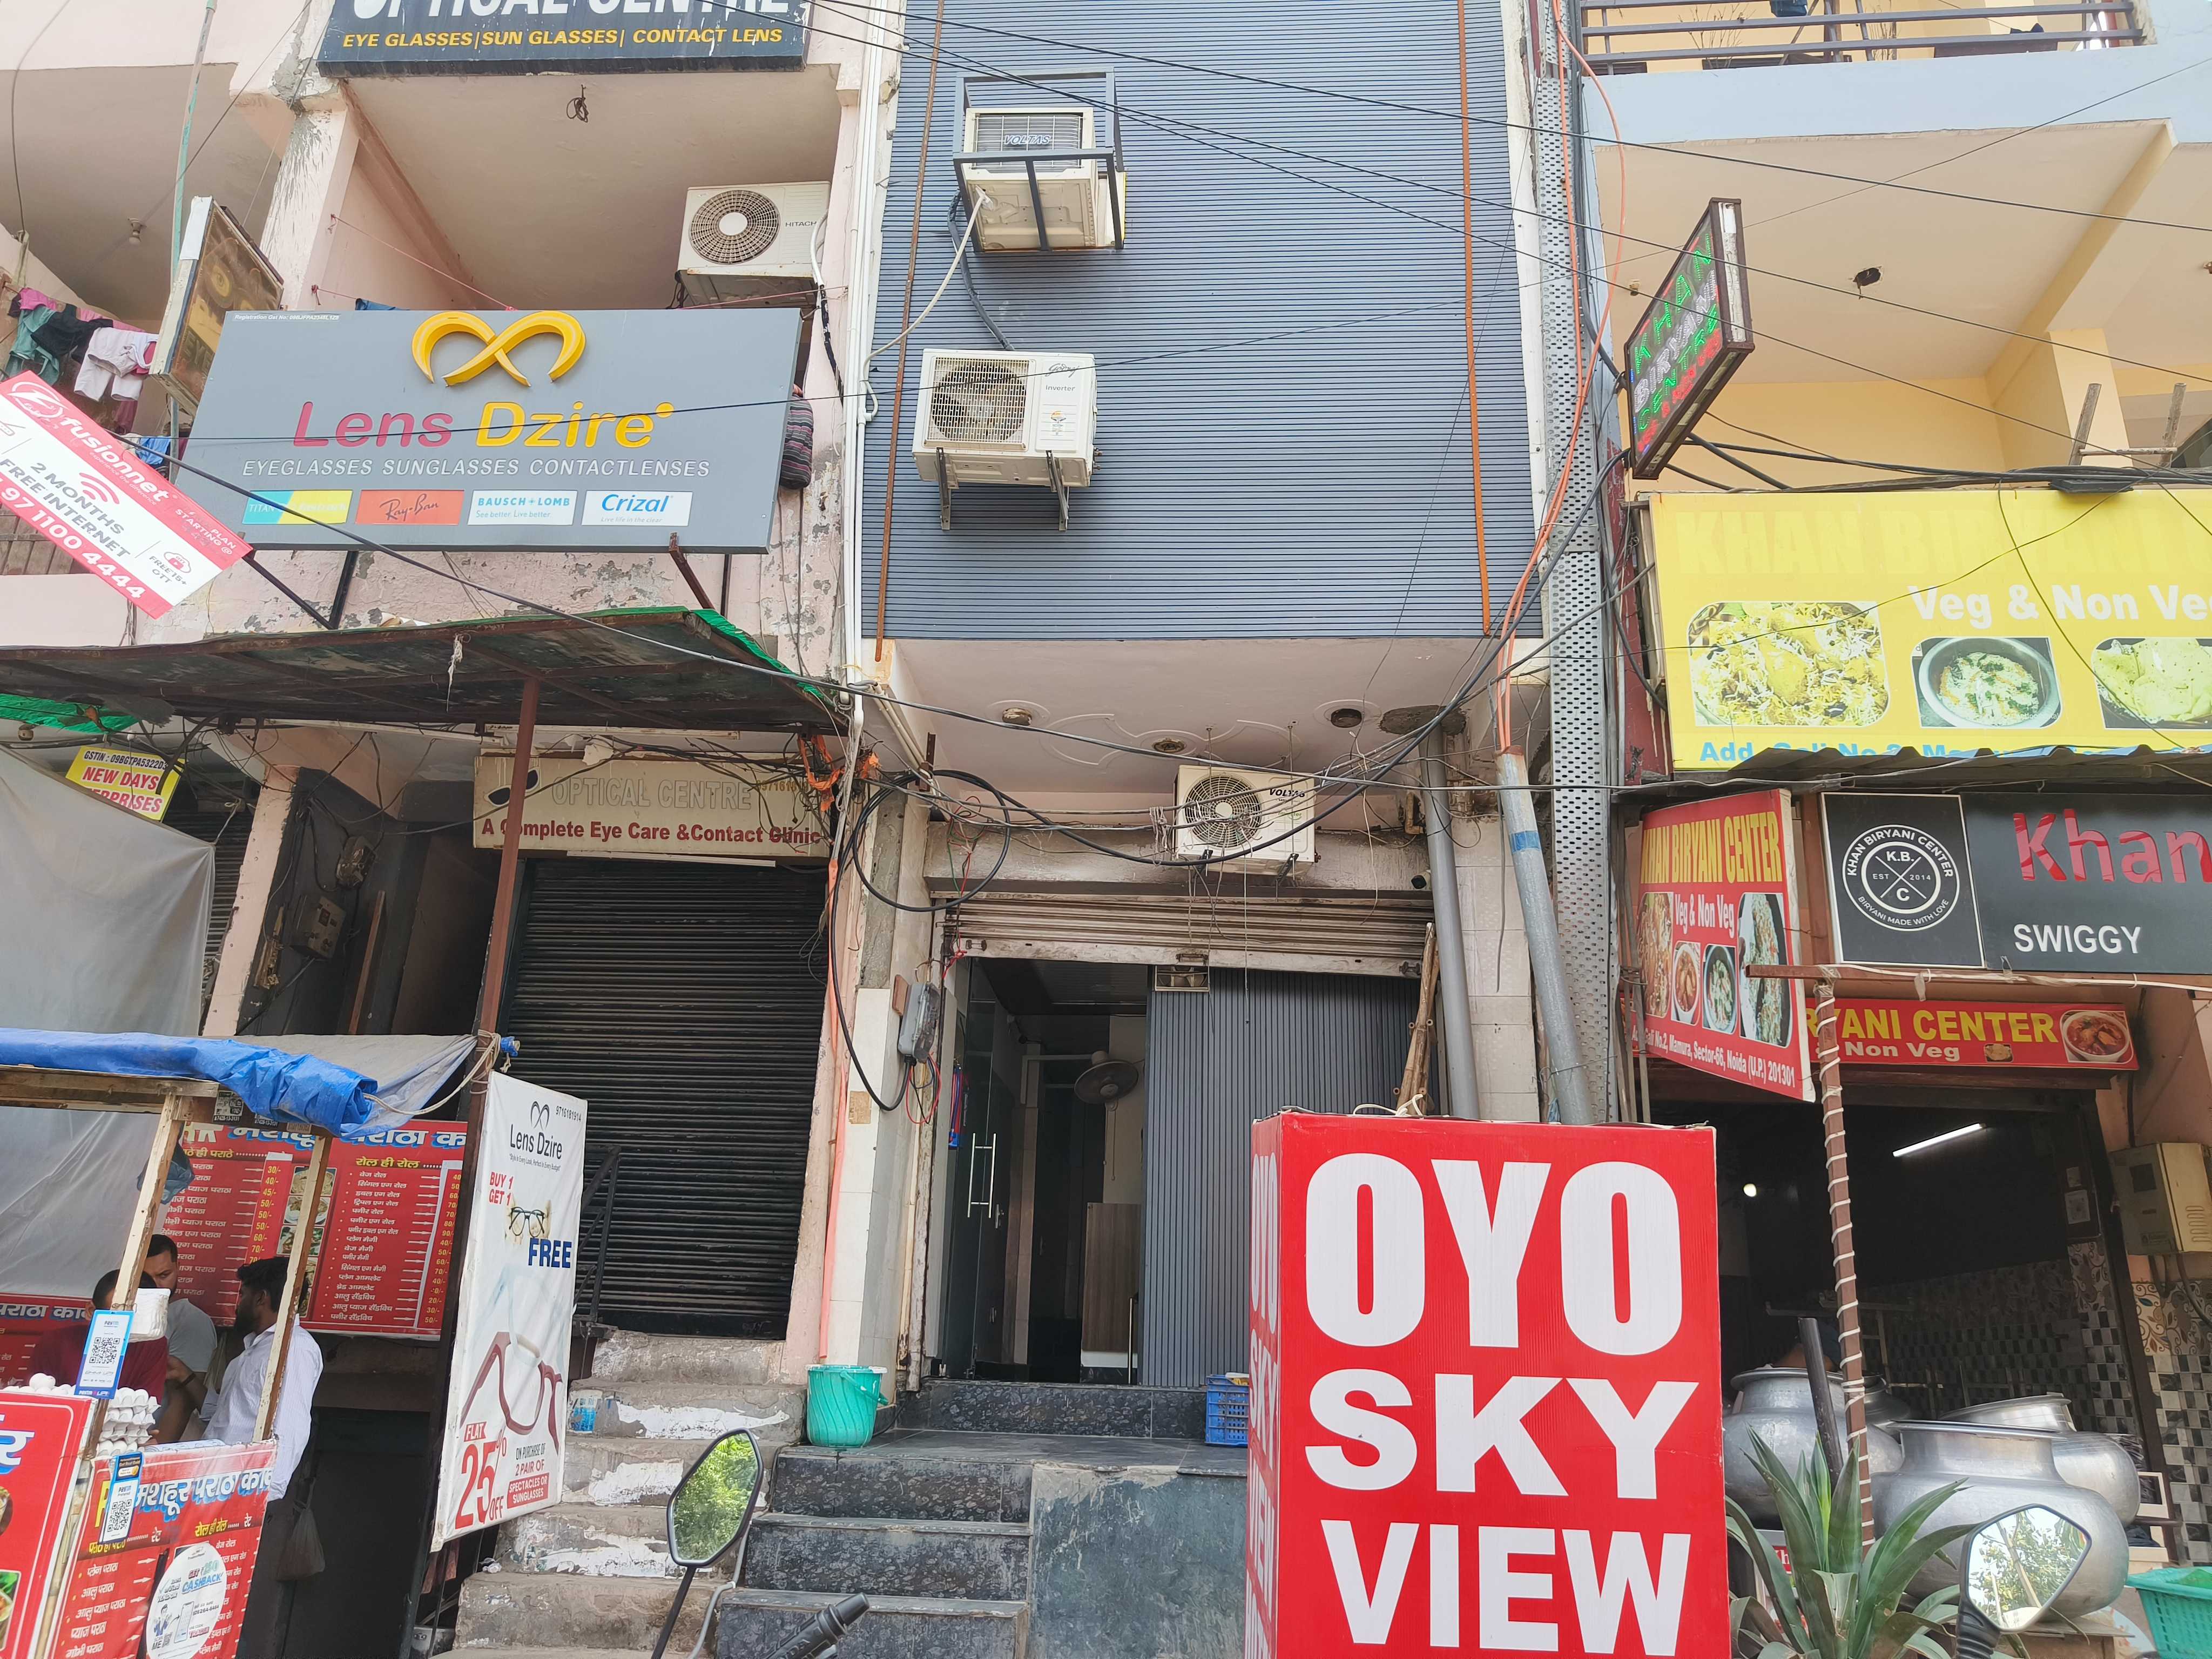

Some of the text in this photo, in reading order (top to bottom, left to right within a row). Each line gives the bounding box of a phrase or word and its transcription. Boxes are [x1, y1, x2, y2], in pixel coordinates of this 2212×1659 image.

[343, 34, 380, 48] EYE
[633, 29, 727, 43] CONTACT
[732, 29, 783, 43] LENS
[1004, 134, 1051, 145] VOLTAS
[293, 401, 657, 448] Lens Dzire
[60, 417, 169, 502] fusionnet
[242, 458, 710, 476] EYEGLASSES SUNGLASSES CONTACTLENSES
[31, 462, 125, 535] 2 MONTHS
[478, 497, 527, 506] BAUSCH
[538, 498, 571, 506] LOMB
[602, 494, 670, 512] Crizal
[43, 491, 132, 559] INTERNET
[175, 509, 222, 547] STARTING
[31, 509, 84, 550] 1100
[80, 552, 148, 599] 4444
[1676, 510, 1865, 574] KHAN
[1908, 584, 2212, 630] Veg & Non Ve
[82, 767, 160, 791] NEW DAYS
[552, 777, 650, 807] OPTICAL
[658, 778, 752, 810] CENTRE
[481, 819, 495, 835] A
[590, 821, 622, 842] Eye
[628, 822, 670, 840] Care
[2013, 808, 2212, 883] Khan
[1671, 819, 1723, 883] BIRYANI
[1724, 811, 1783, 884] CENTER
[1847, 829, 1954, 878] KHAN BIRYANI CENTER
[1886, 851, 1914, 861] K.B.
[1896, 887, 1910, 901] C
[1675, 894, 1736, 938] Veg & Non Veg
[1858, 896, 1950, 926] BIRYANI MADE WITH LOVE
[2013, 923, 2142, 954] SWIGGY
[1913, 1010, 2059, 1043] CENTER
[1845, 1041, 1961, 1062] Non Veg
[1727, 1049, 1747, 1073] Noida
[1768, 1060, 1796, 1088] 201301
[556, 1106, 582, 1122] 9716181914
[510, 1124, 562, 1159] Lens Dzire
[268, 1166, 281, 1175] 30/-
[490, 1171, 514, 1189] BUY 1
[261, 1199, 274, 1208] 50/-
[489, 1189, 512, 1206] GET 1
[256, 1222, 269, 1231] 50/-
[259, 1211, 272, 1219] 50/-
[254, 1233, 267, 1242] 60/-
[1251, 1152, 1278, 1334] OYO
[528, 1238, 572, 1269] FREE
[1306, 1152, 1682, 1355] OYO
[1250, 1328, 1278, 1471] SKY
[466, 1424, 484, 1441] FLAT
[1305, 1368, 1700, 1500] SKY
[520, 1461, 535, 1474] PAIR
[536, 1459, 545, 1471] OF
[509, 1475, 548, 1493] SPECTACLES OR
[512, 1488, 544, 1504] SUNGLASSES
[489, 1496, 504, 1521] OFF
[1320, 1519, 1692, 1656] VIEW
